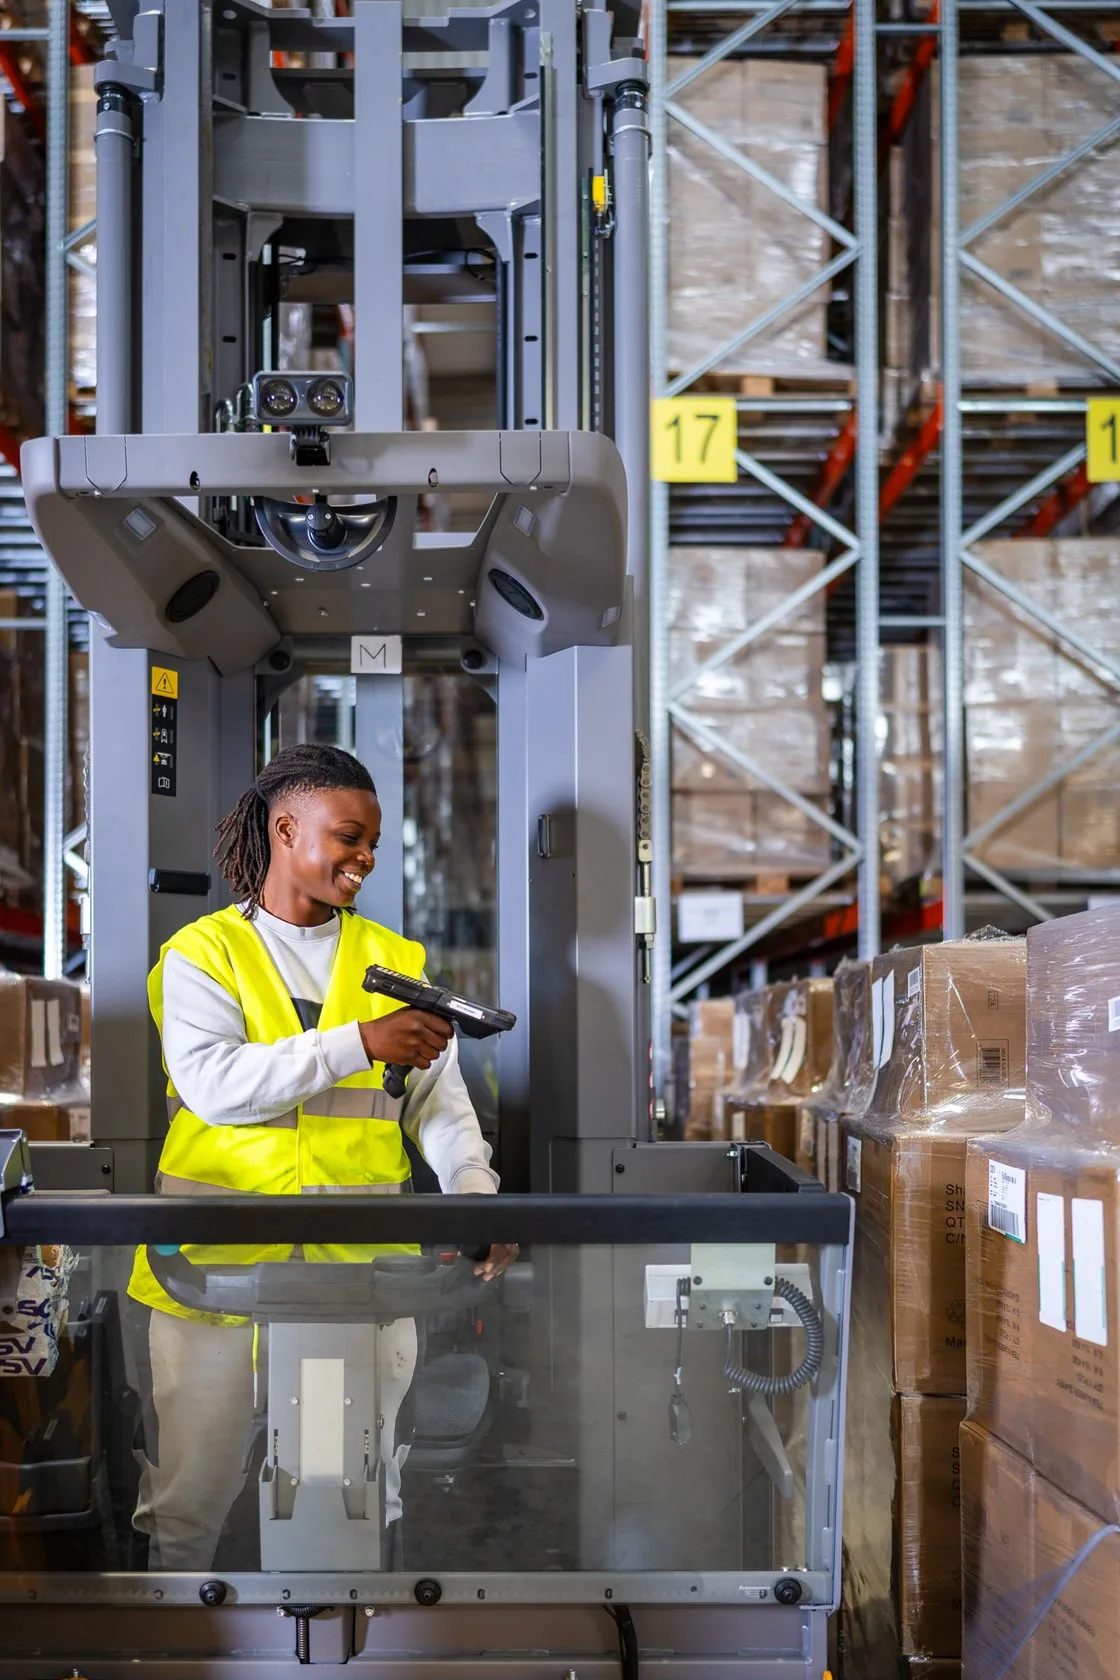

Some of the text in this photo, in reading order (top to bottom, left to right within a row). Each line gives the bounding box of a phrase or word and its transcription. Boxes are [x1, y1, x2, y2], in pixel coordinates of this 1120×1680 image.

[665, 413, 719, 465] 17
[360, 643, 387, 669] M
[946, 1184, 965, 1195] Sh
[945, 1336, 966, 1348] Ma
